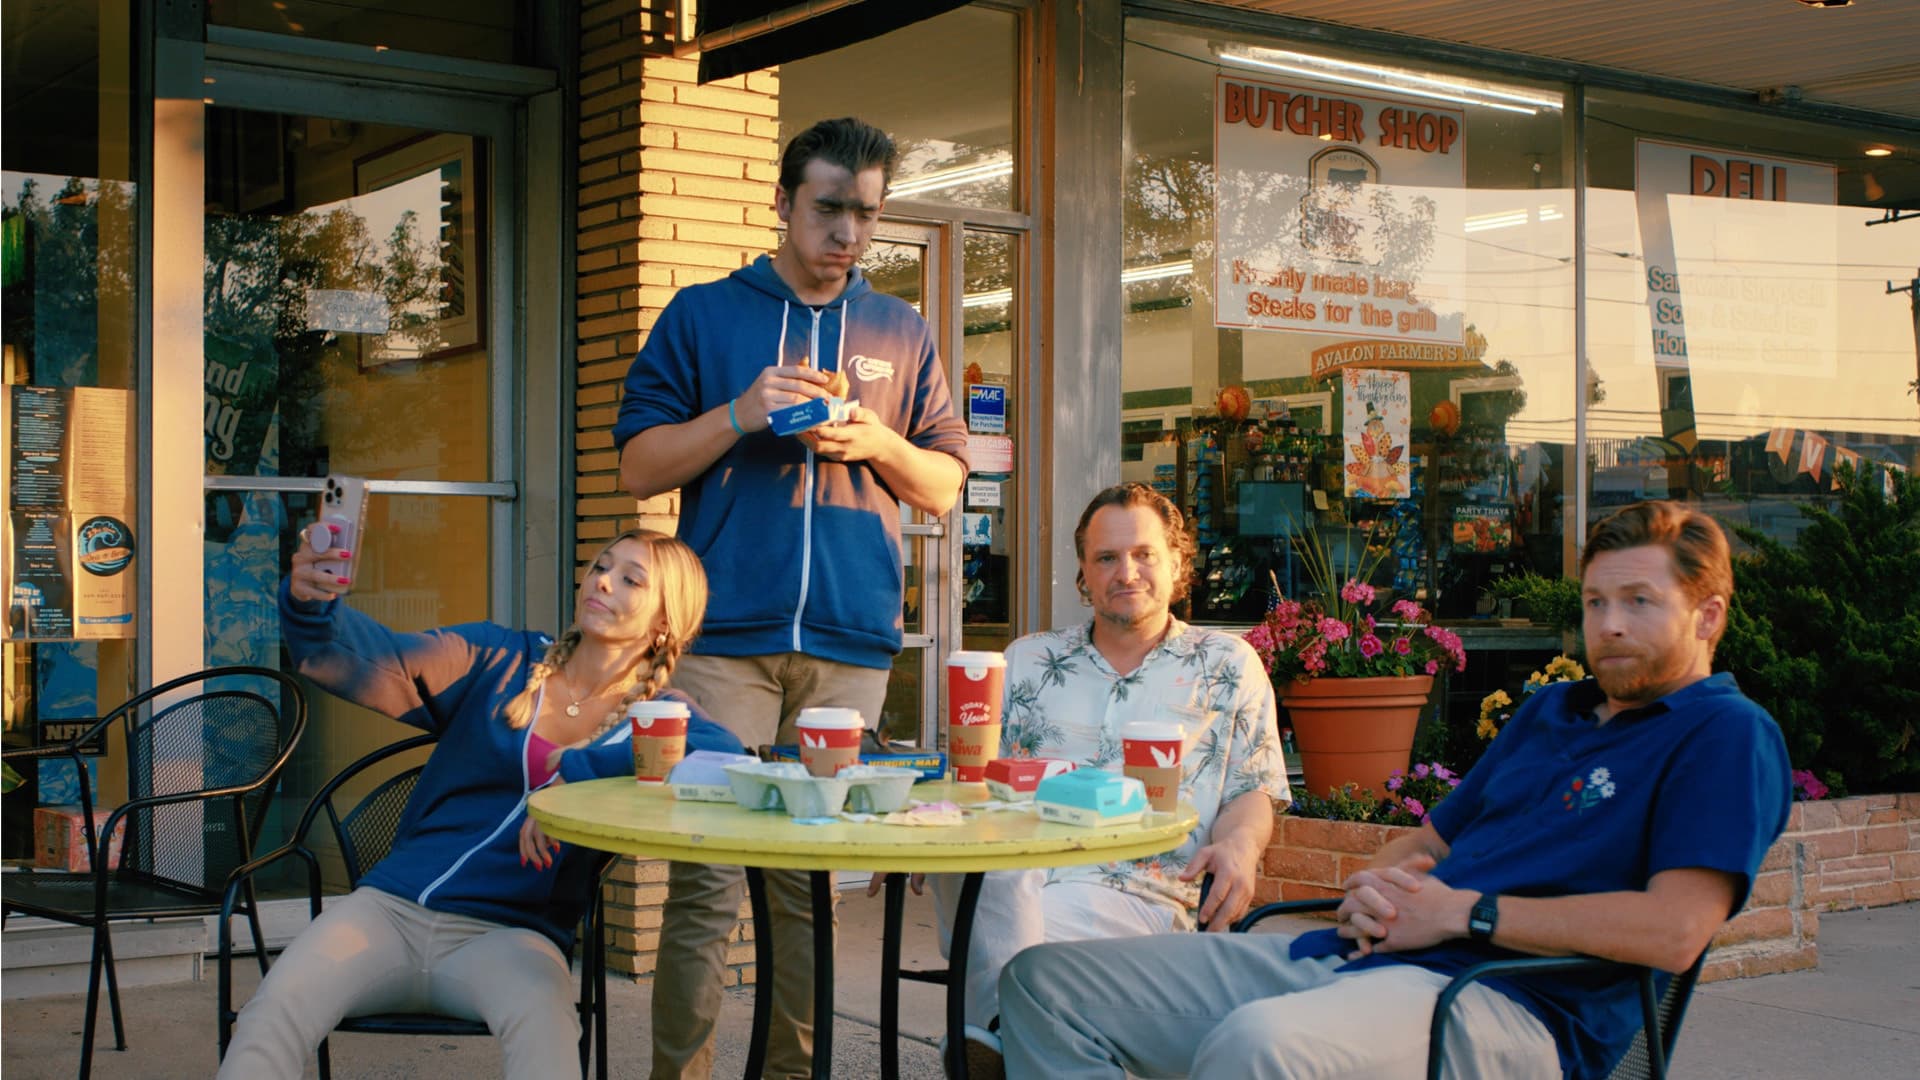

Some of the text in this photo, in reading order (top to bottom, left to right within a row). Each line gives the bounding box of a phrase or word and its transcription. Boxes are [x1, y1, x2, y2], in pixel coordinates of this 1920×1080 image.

[1224, 82, 1459, 154] BUTCHER SHOP
[1311, 271, 1369, 298] made
[1247, 291, 1438, 334] Steaks for the grill
[1315, 344, 1376, 372] AVALON
[1379, 343, 1458, 361] FARMER'S
[977, 389, 1001, 401] MAC
[1366, 372, 1398, 395] Happy
[1455, 506, 1509, 517] PARTY TRAYS
